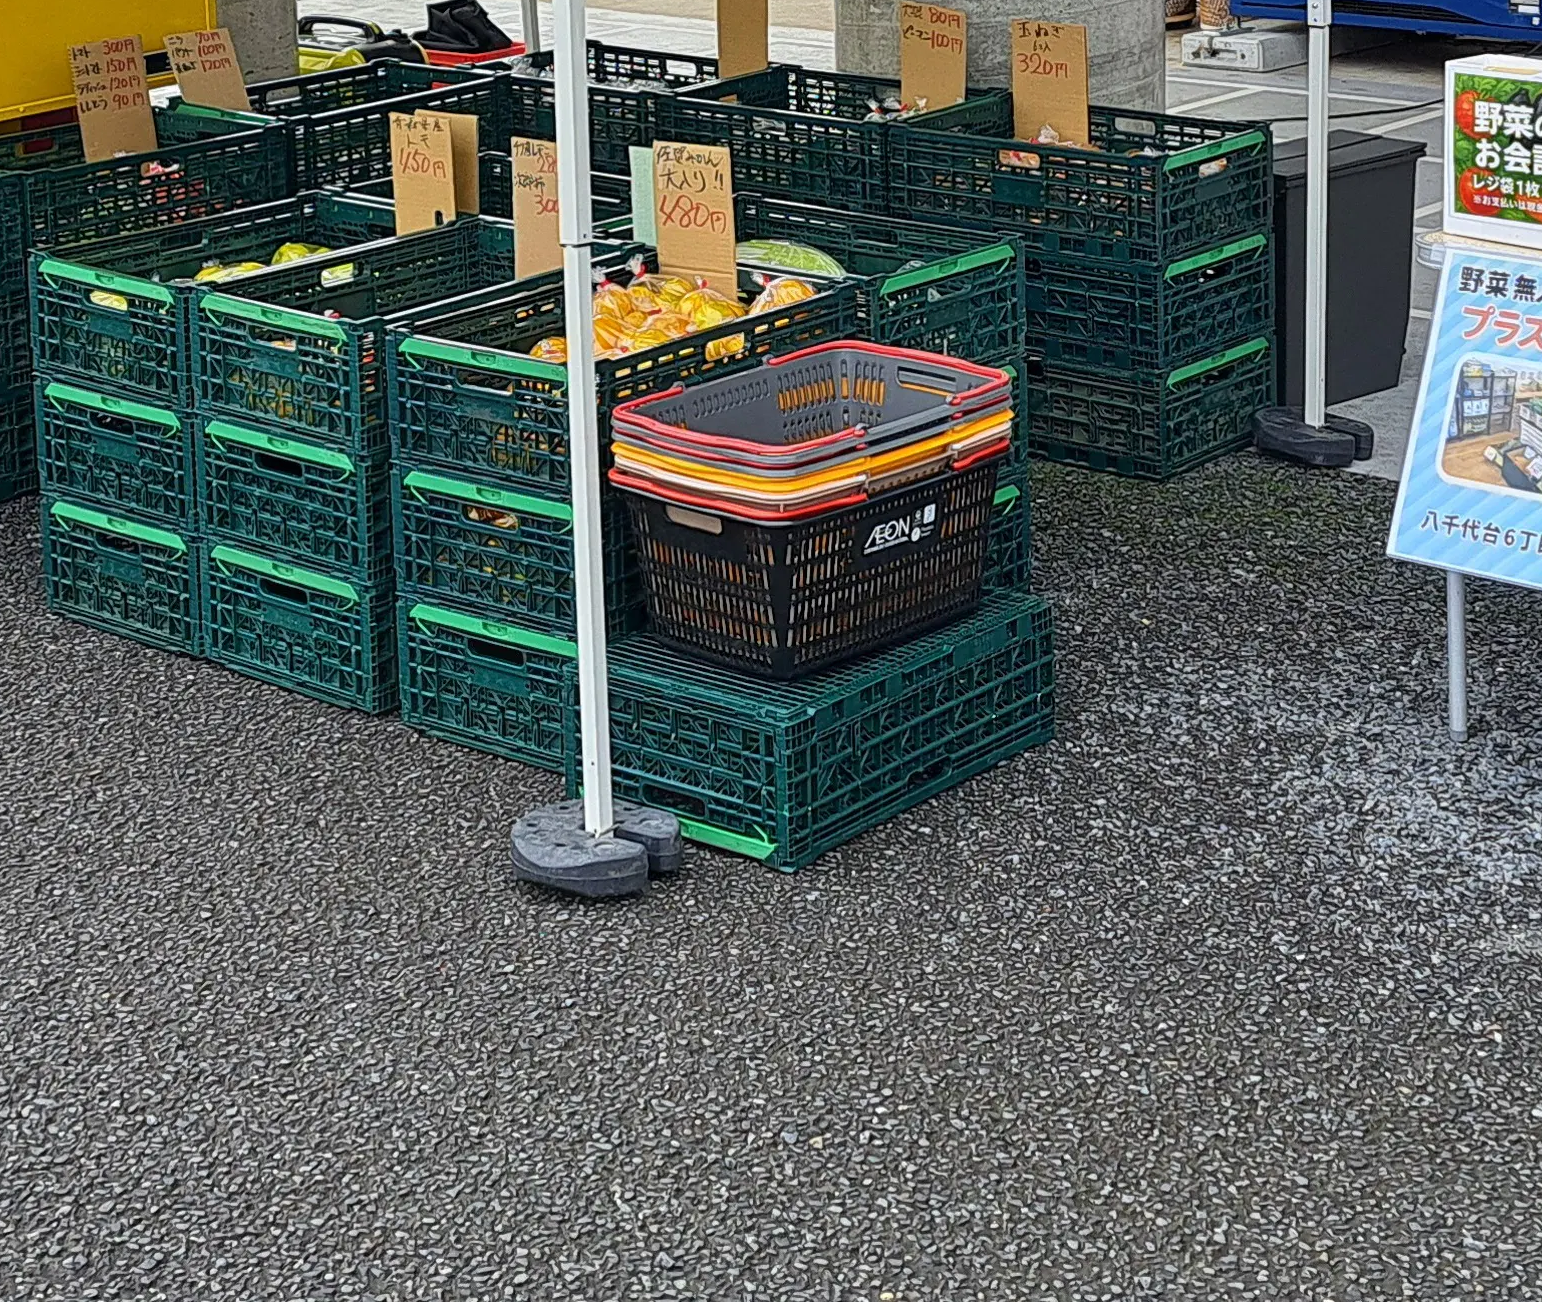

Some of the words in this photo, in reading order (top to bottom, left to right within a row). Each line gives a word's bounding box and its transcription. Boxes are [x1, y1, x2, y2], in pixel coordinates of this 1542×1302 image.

[928, 7, 961, 29] 80円
[102, 39, 135, 55] 300円
[197, 43, 226, 58] 100円
[931, 30, 963, 54] 100円
[106, 57, 138, 73] 150円
[1016, 52, 1068, 78] 320円
[109, 75, 141, 92] 120円
[112, 92, 145, 110] 90円
[399, 147, 447, 178] 450円
[659, 194, 727, 234] 480円
[1459, 265, 1511, 299] 野菜
